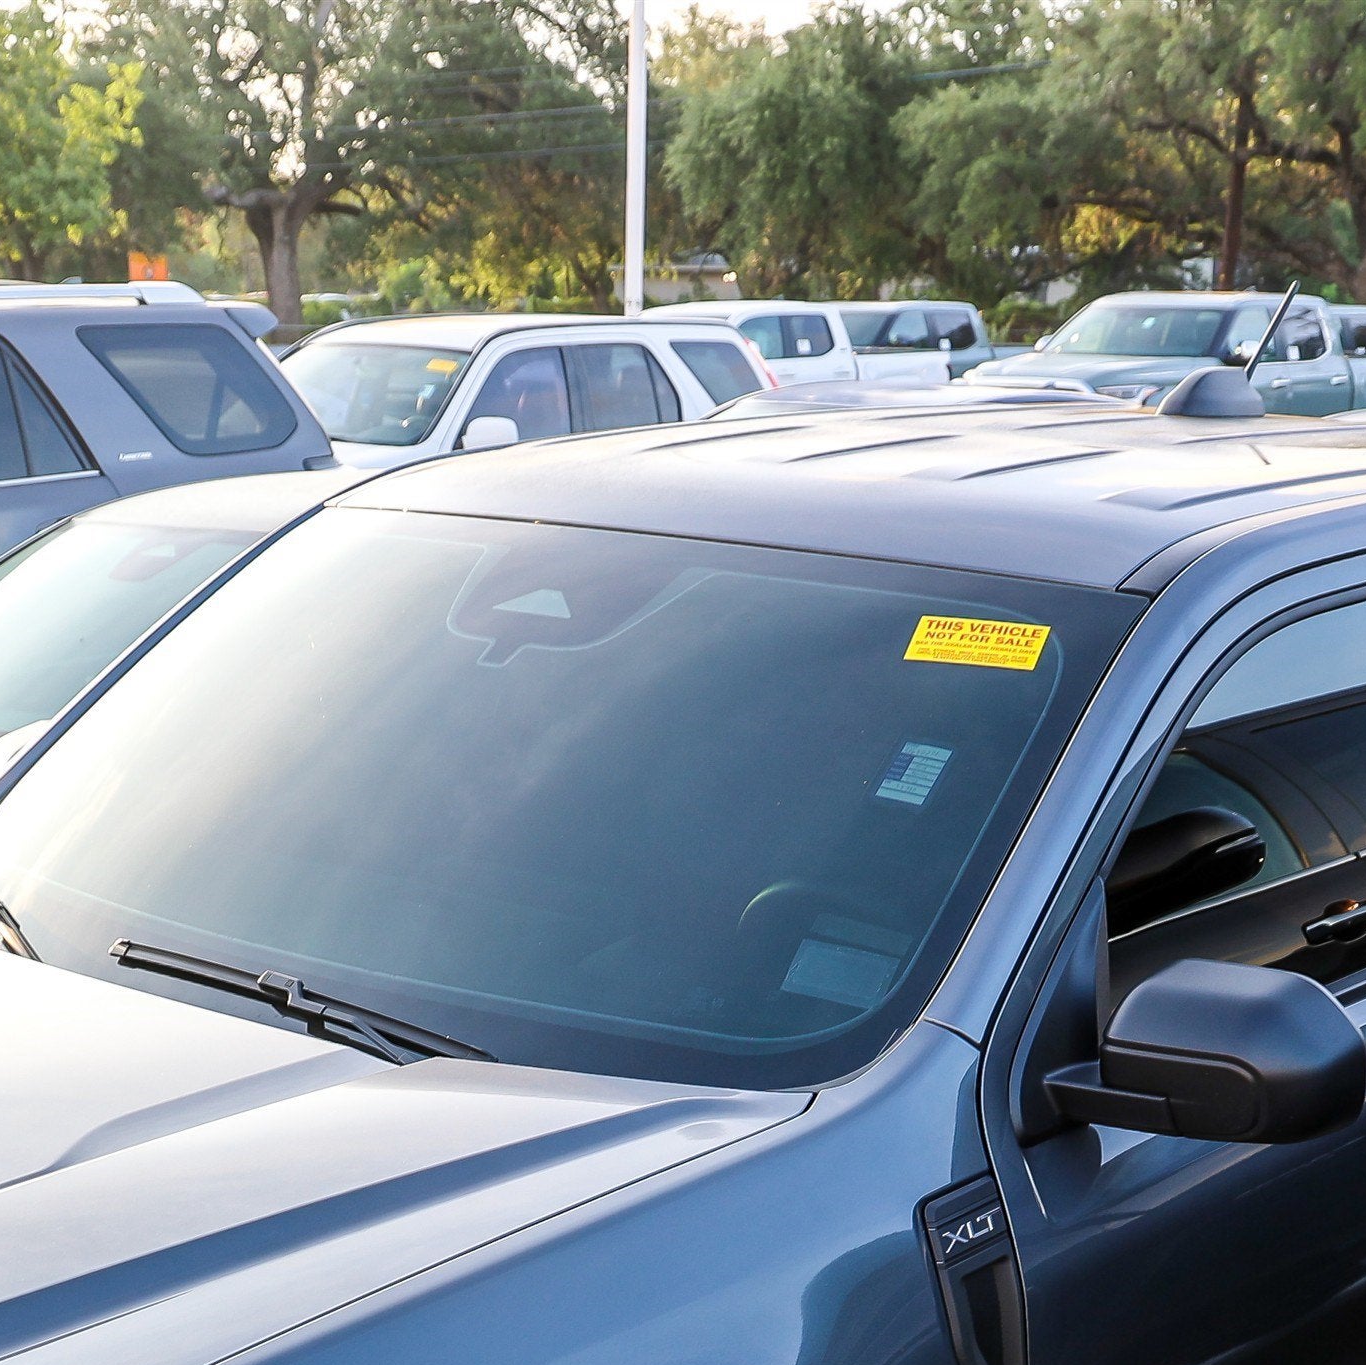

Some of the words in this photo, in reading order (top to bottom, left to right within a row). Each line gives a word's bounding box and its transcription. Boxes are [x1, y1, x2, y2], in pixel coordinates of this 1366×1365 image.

[927, 619, 965, 632] THIS
[970, 623, 1044, 639] VEHICLE
[925, 631, 956, 640] NOT
[960, 634, 990, 643] FOR
[995, 637, 1036, 648] SALE
[941, 1206, 1001, 1254] XLT
